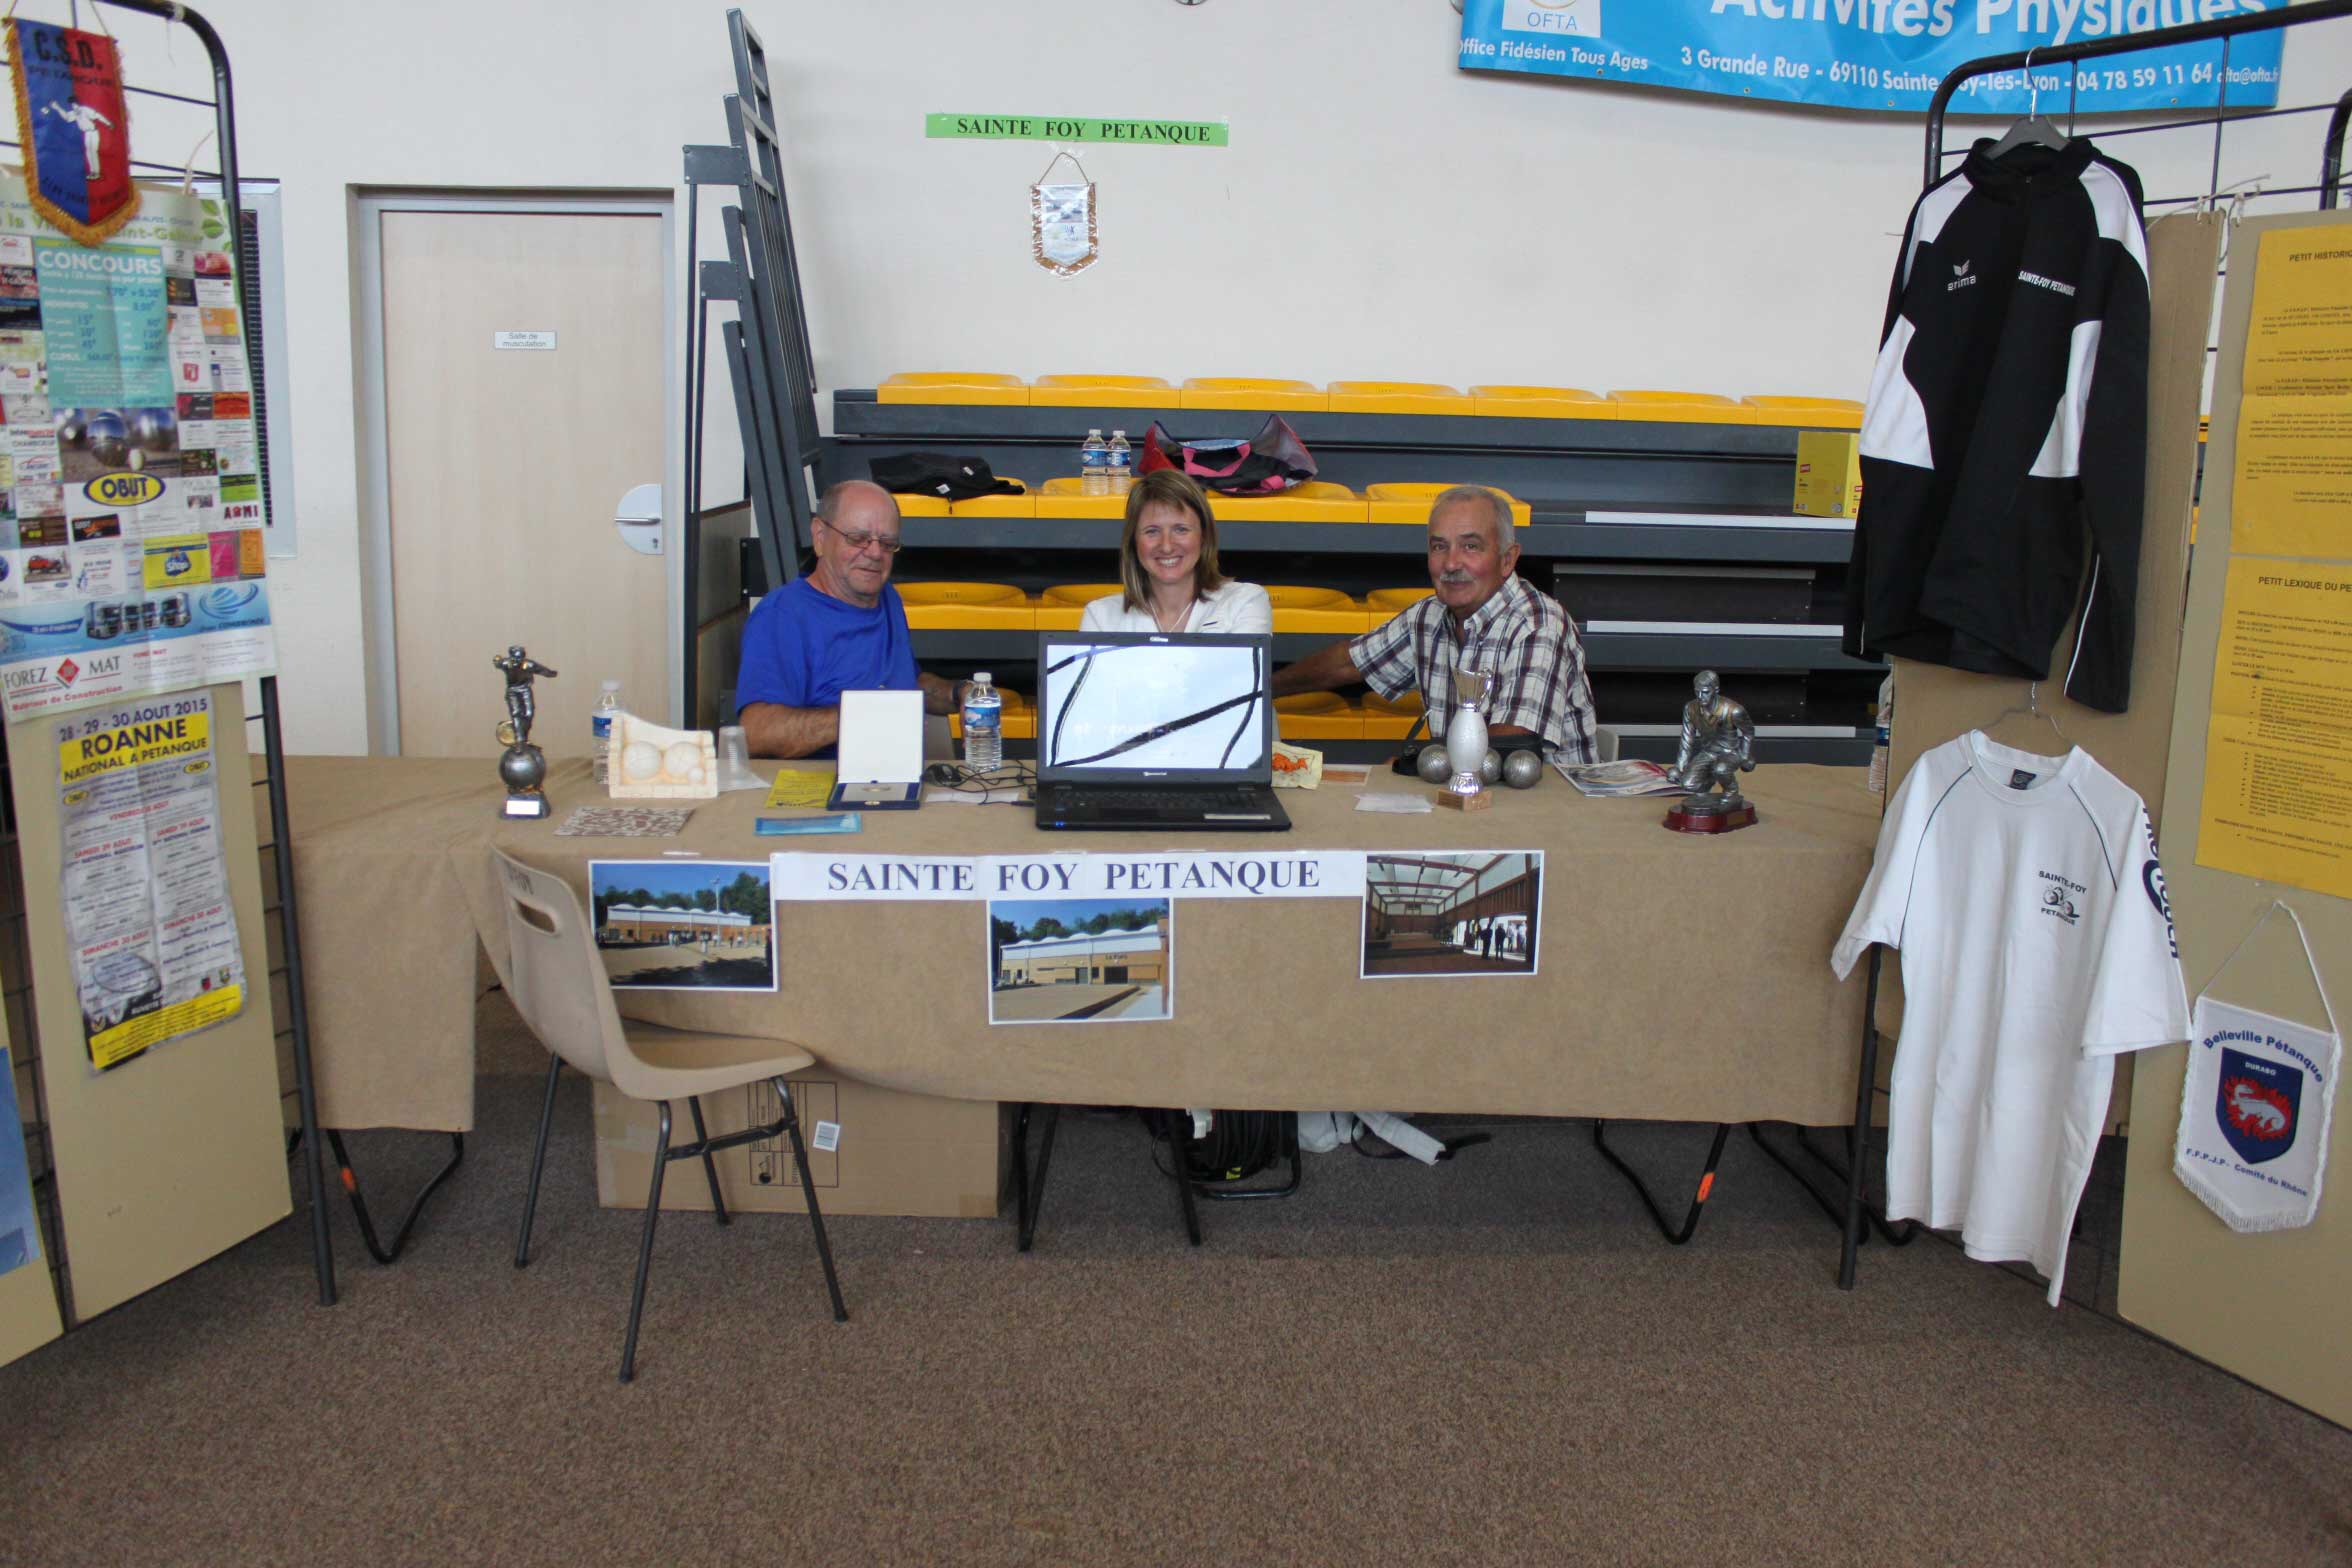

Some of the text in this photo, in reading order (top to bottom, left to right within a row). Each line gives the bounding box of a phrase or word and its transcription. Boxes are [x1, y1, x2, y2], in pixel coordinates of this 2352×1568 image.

[1527, 12, 1577, 31] OFTA
[1977, 0, 2267, 47] Physique
[1500, 41, 1566, 62] Fidésien
[1571, 47, 1605, 65] Tous
[1609, 51, 1649, 72] Ages
[1681, 47, 1692, 66] 3
[1697, 49, 1768, 77] Grande
[1773, 56, 1810, 79] Rue
[1829, 61, 1878, 88] 69110
[1882, 70, 2060, 96] Sainte-oy-lès-Lyon
[2076, 71, 2098, 92] 04
[2103, 70, 2127, 90] 78
[2133, 67, 2156, 88] 59
[2162, 64, 2184, 85] 11
[2191, 62, 2213, 83] 64
[957, 118, 1211, 144] SAINTE FOY PETANQUE
[38, 250, 161, 275] CONCOURS
[2289, 252, 2312, 262] PETIT
[100, 477, 149, 499] OBUT
[2258, 576, 2282, 586] PETIT
[2284, 578, 2322, 590] LEXIQUE
[2324, 582, 2338, 591] DU
[4, 667, 48, 689] FOREZ
[89, 656, 121, 675] MAT
[84, 719, 99, 735] 29
[112, 713, 130, 728] 30
[133, 705, 171, 724] AOUT
[175, 698, 207, 716] 2015
[81, 718, 188, 760] ROANNE
[63, 737, 207, 782] NATIONAL A PETANQUE
[827, 859, 1321, 895] SAINTE FOY PETANQUE
[2038, 870, 2087, 894] SAINTE-FOY
[2203, 1030, 2323, 1084] Belleville Pétanque
[2234, 1163, 2265, 1180] Comité
[2267, 1176, 2279, 1185] du
